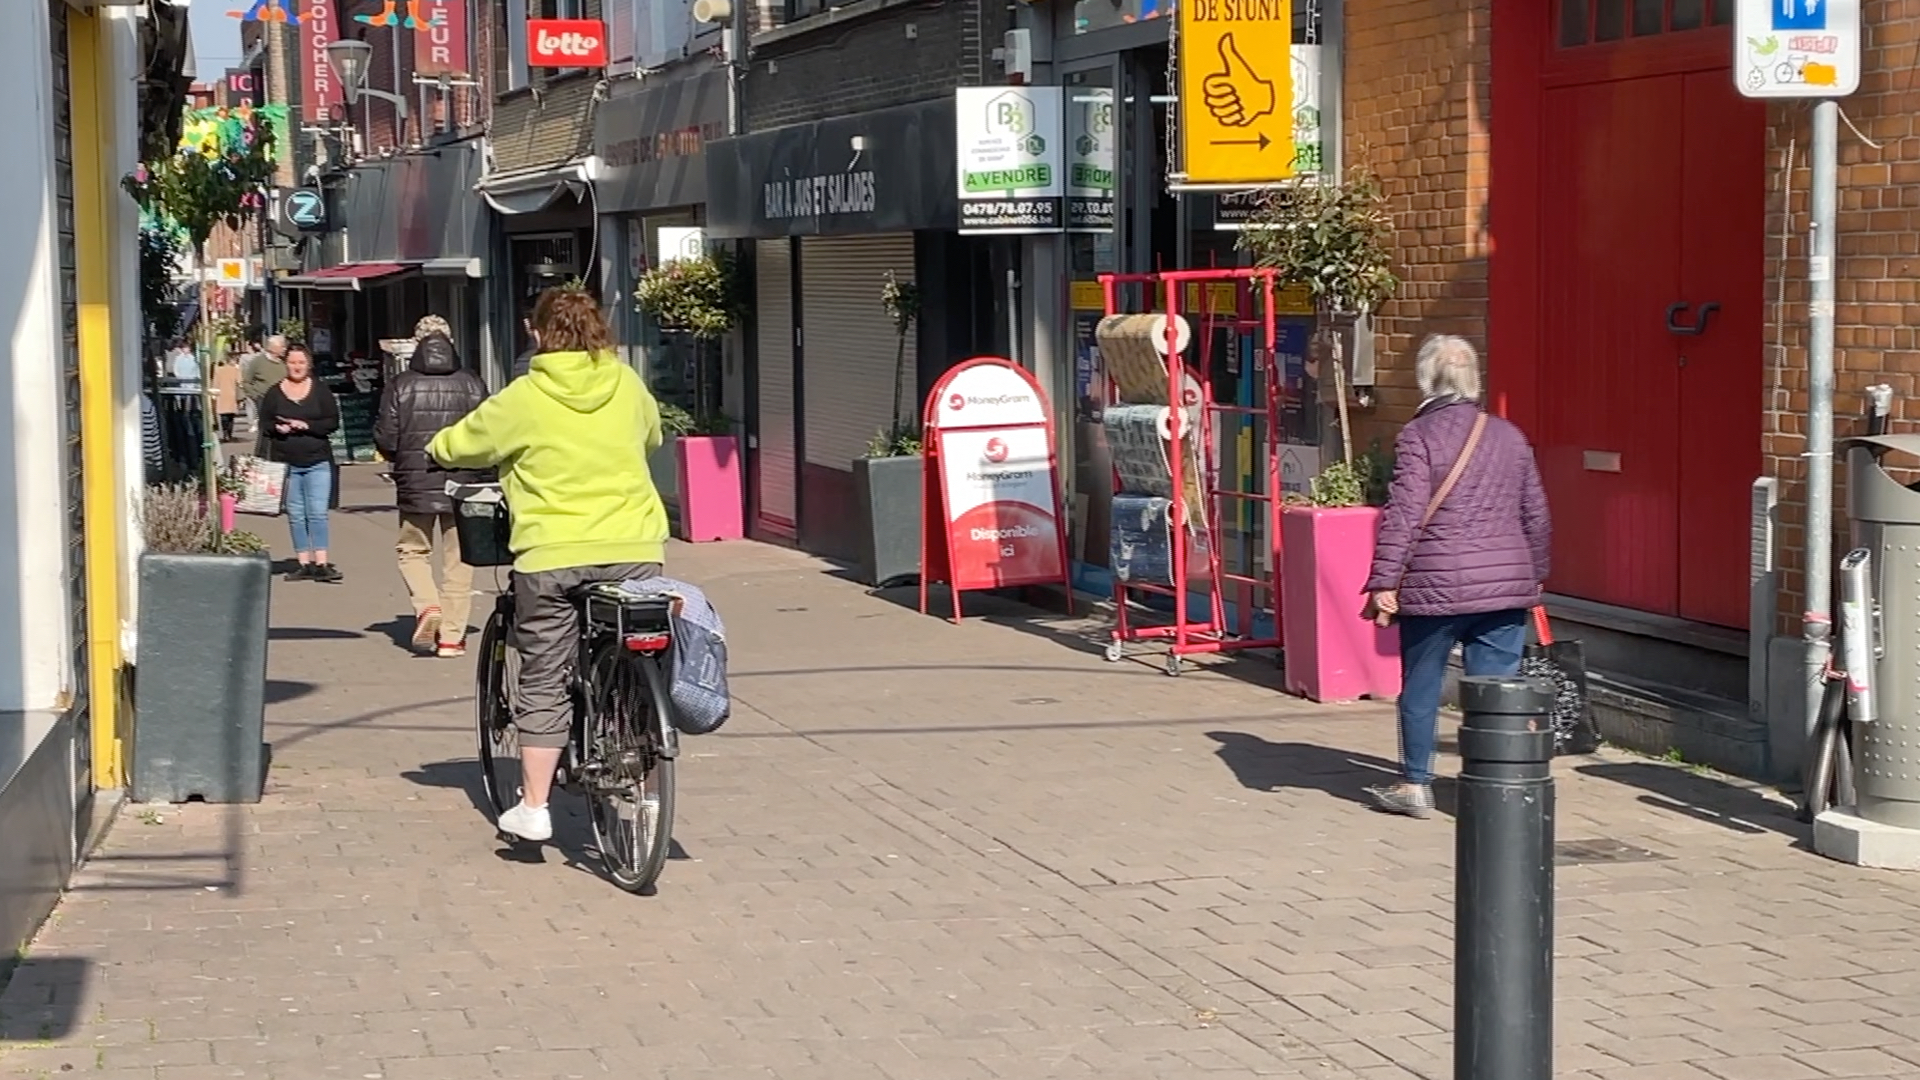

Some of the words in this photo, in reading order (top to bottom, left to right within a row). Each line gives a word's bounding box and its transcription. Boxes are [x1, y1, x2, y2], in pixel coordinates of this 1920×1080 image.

[1193, 0, 1219, 21] DE
[1224, 0, 1283, 21] STUNT
[310, 0, 330, 122] OUCHERIE
[981, 166, 1048, 187] VENDRE
[764, 182, 784, 218] BAR
[812, 175, 827, 215] ET
[827, 170, 875, 214] SALADES
[963, 202, 1052, 216] 0478/78.07.95
[967, 394, 1030, 406] MoneyGram
[966, 470, 1033, 482] MoneyGram
[970, 525, 1039, 541] Disponible
